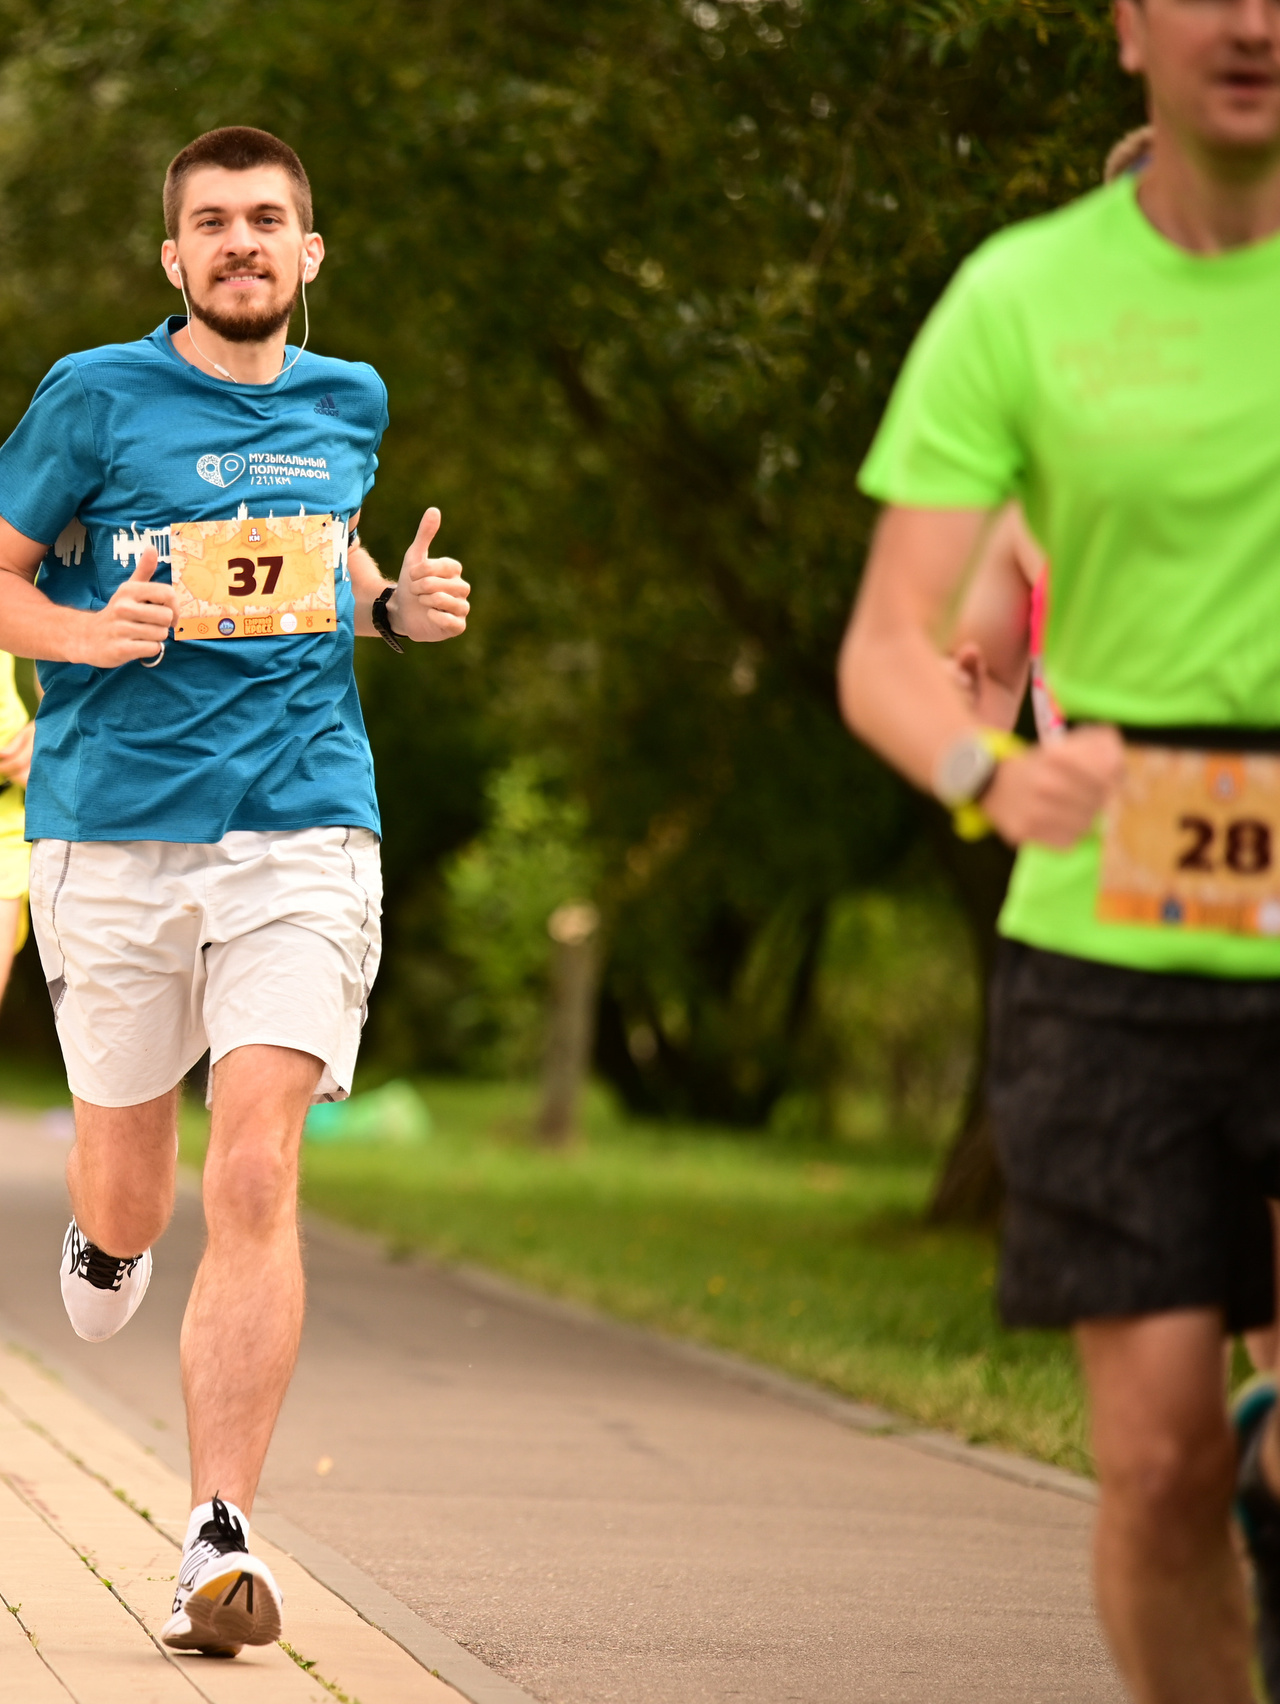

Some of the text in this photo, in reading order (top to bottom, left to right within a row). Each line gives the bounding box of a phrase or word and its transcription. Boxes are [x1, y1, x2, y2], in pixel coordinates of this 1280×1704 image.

[249, 453, 327, 468] МУЗЫКАЛЬНЫЙ
[249, 465, 330, 480] ПОЛУМАРАФОН
[256, 476, 274, 486] 21,1
[275, 476, 291, 485] КМ
[227, 556, 283, 597] 37
[1177, 813, 1272, 874] 28
